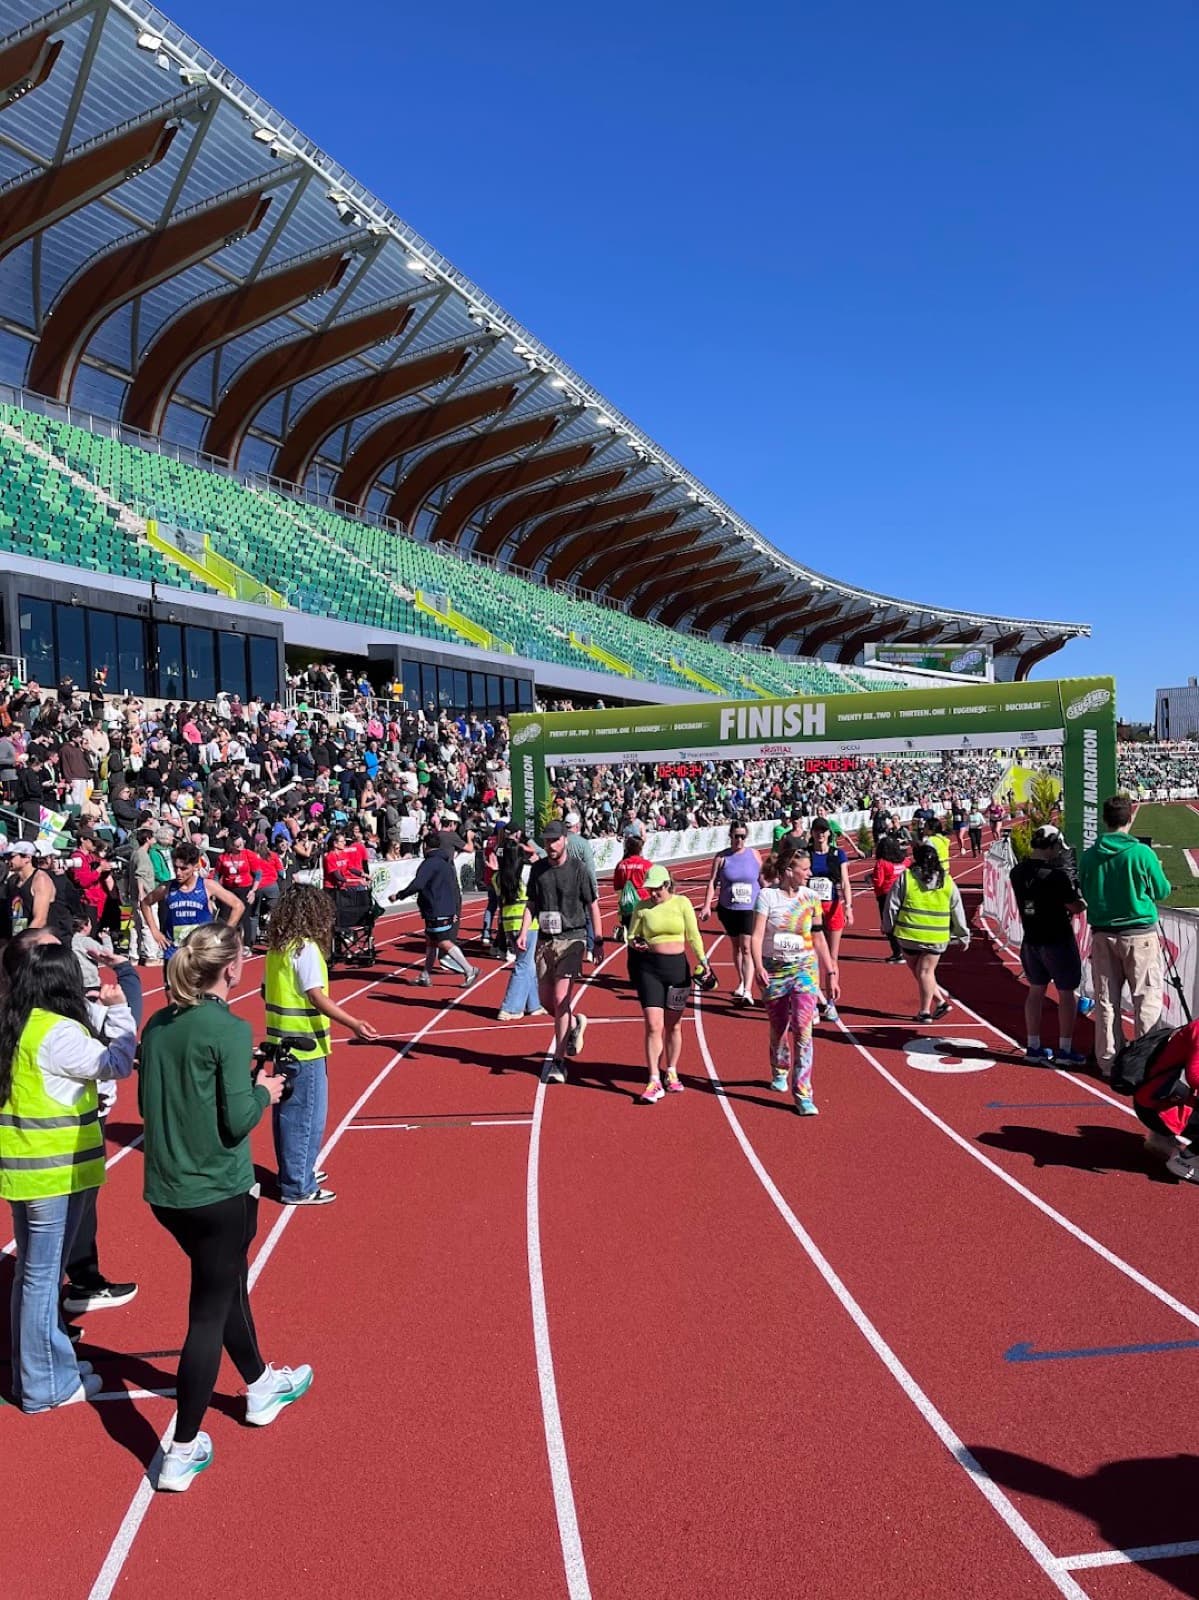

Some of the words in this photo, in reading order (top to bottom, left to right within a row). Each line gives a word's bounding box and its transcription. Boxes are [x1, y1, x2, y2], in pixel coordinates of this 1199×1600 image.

[720, 703, 826, 740] FINISH
[523, 754, 535, 816] MARATHON
[1083, 729, 1098, 803] MARATHON
[1083, 805, 1098, 851] UGENE
